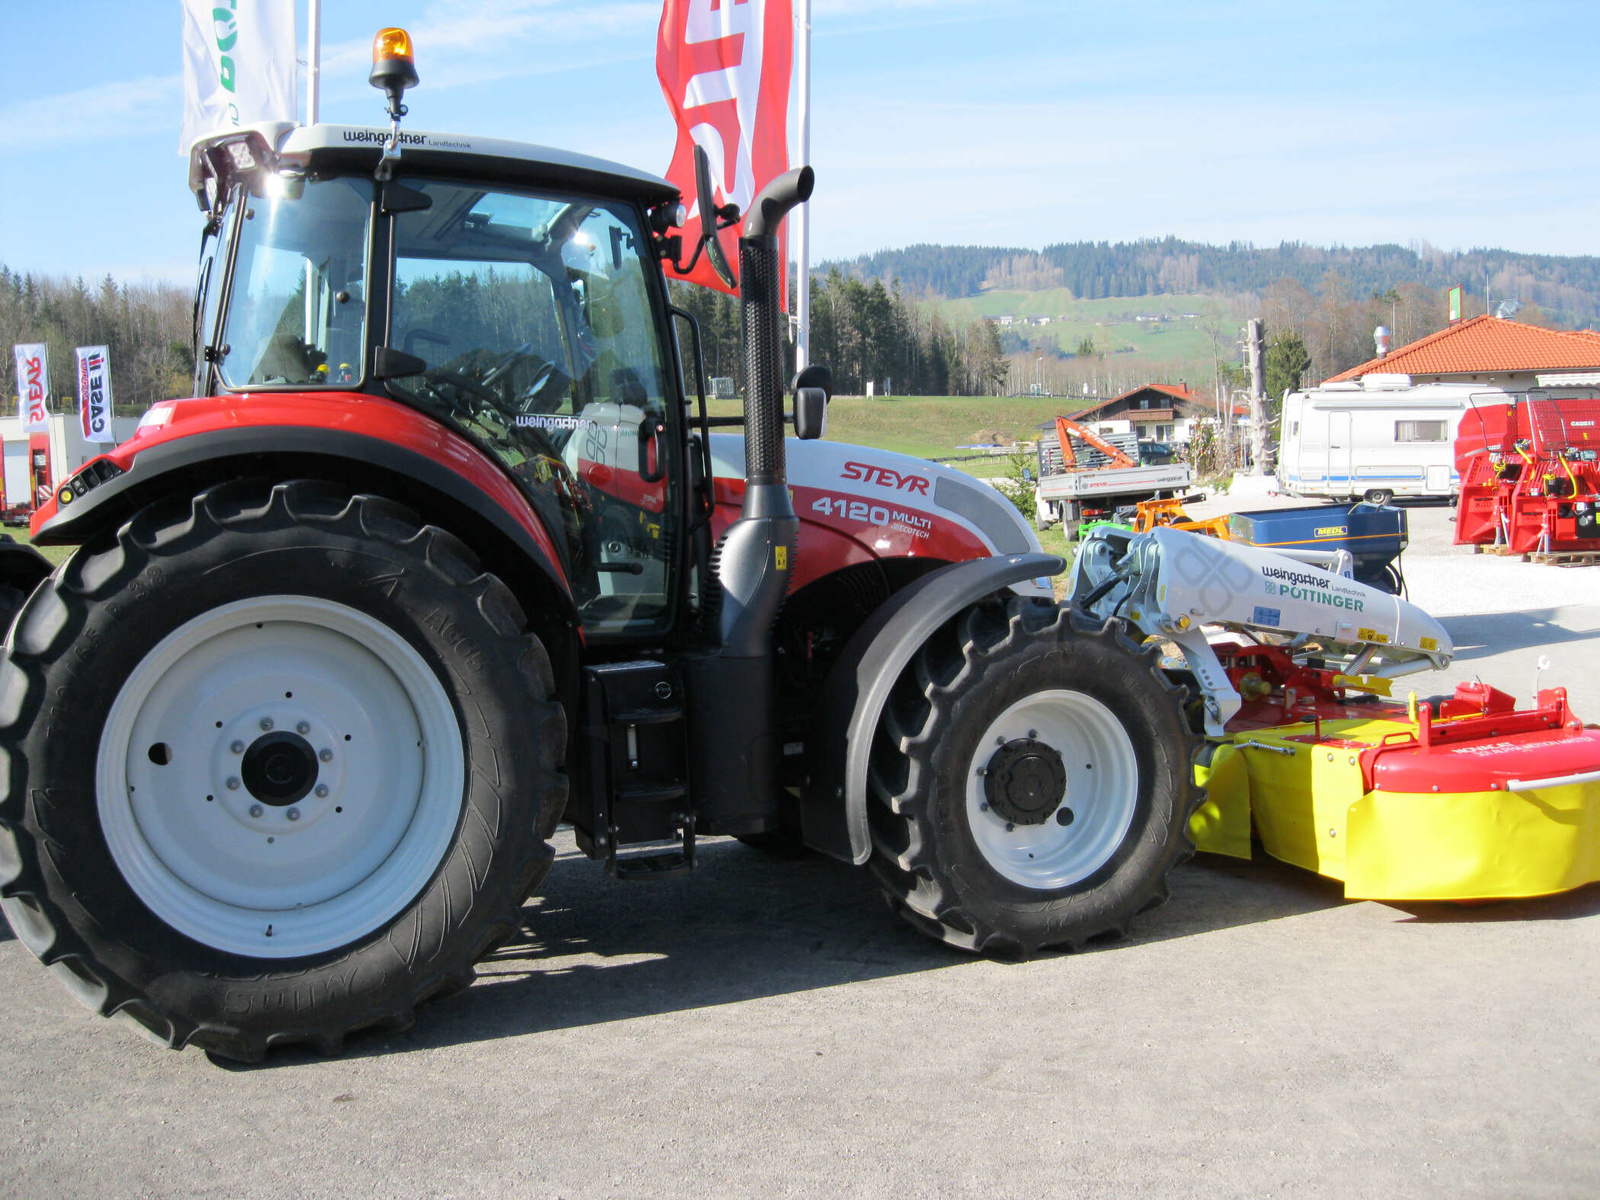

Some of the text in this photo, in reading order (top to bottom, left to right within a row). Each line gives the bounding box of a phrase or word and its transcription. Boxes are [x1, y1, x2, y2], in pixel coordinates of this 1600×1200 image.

[343, 130, 427, 146] weingatner
[515, 415, 592, 431] weingartner
[840, 461, 930, 496] STEYR
[812, 497, 932, 529] 4120 MULTI
[1317, 526, 1345, 536] MEDL
[1261, 566, 1367, 598] weingartner Landtechnik
[1279, 584, 1364, 612] PÖTTINGER
